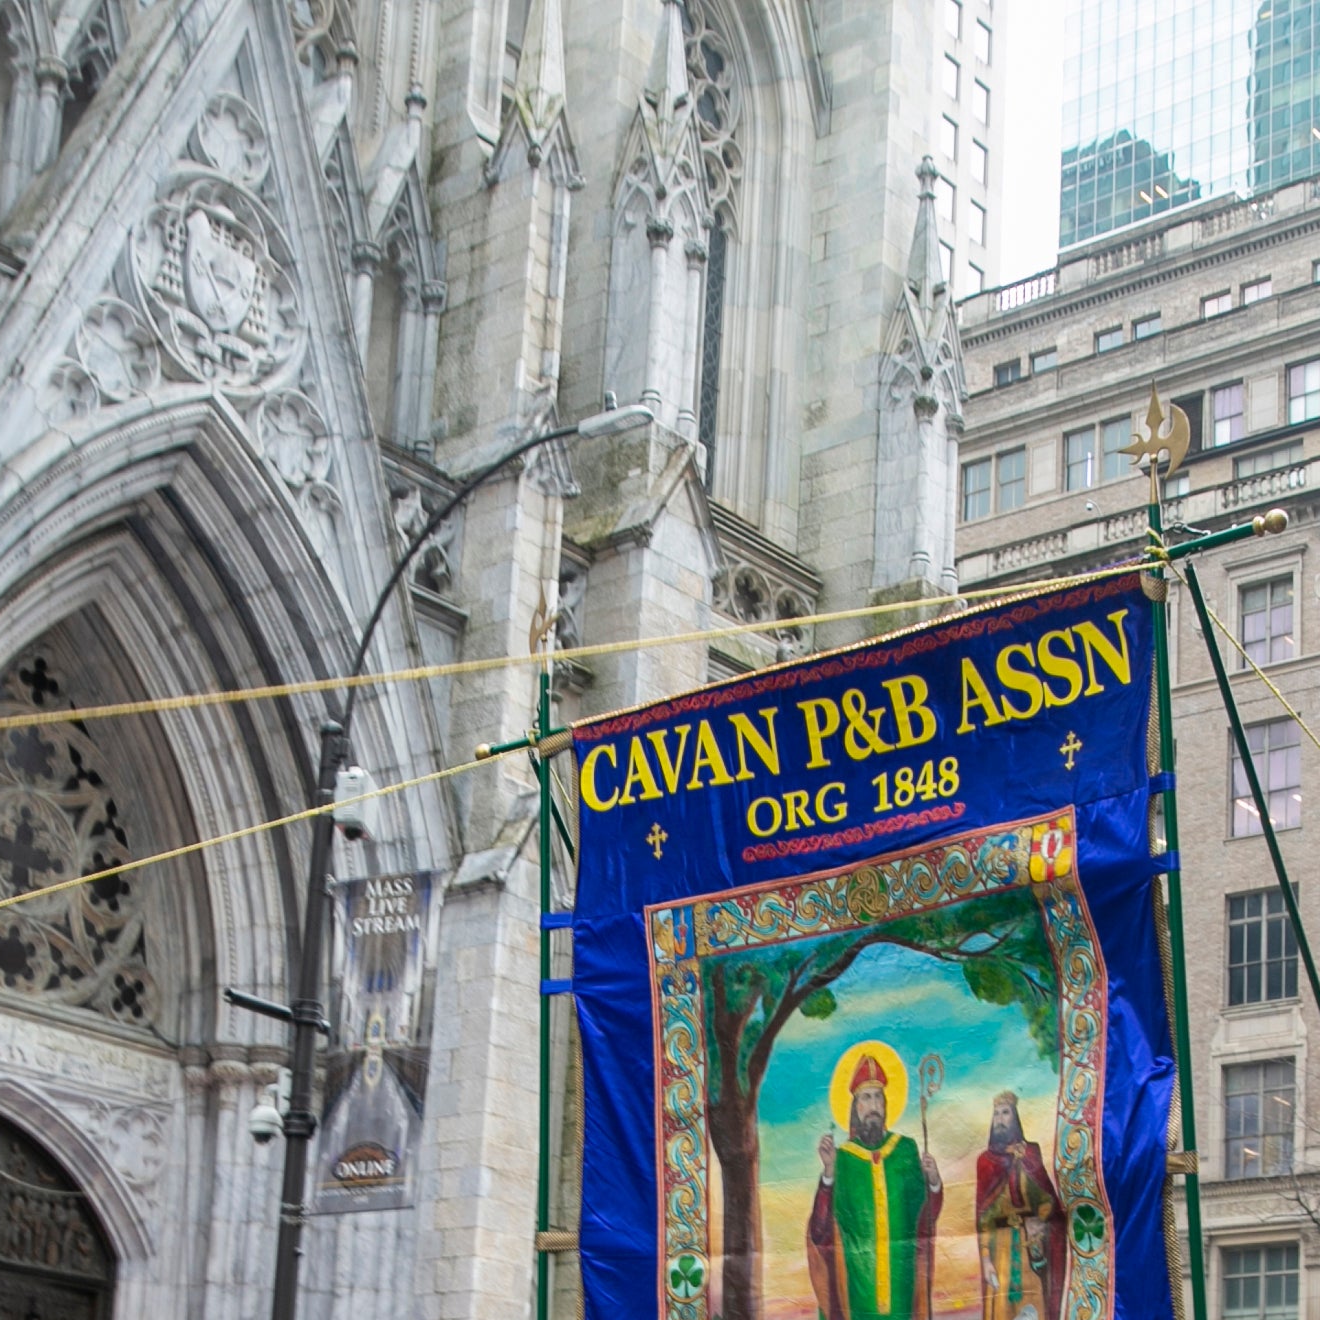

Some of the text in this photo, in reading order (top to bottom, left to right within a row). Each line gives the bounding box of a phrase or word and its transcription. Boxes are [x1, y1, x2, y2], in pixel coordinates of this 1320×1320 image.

[580, 609, 1133, 812] CAVAN P&B ASSN
[746, 757, 960, 838] ORG 1848
[364, 877, 413, 899] MASS
[368, 896, 407, 916] LIVE
[351, 913, 420, 937] STREAM
[335, 1158, 395, 1178] ONLINE
